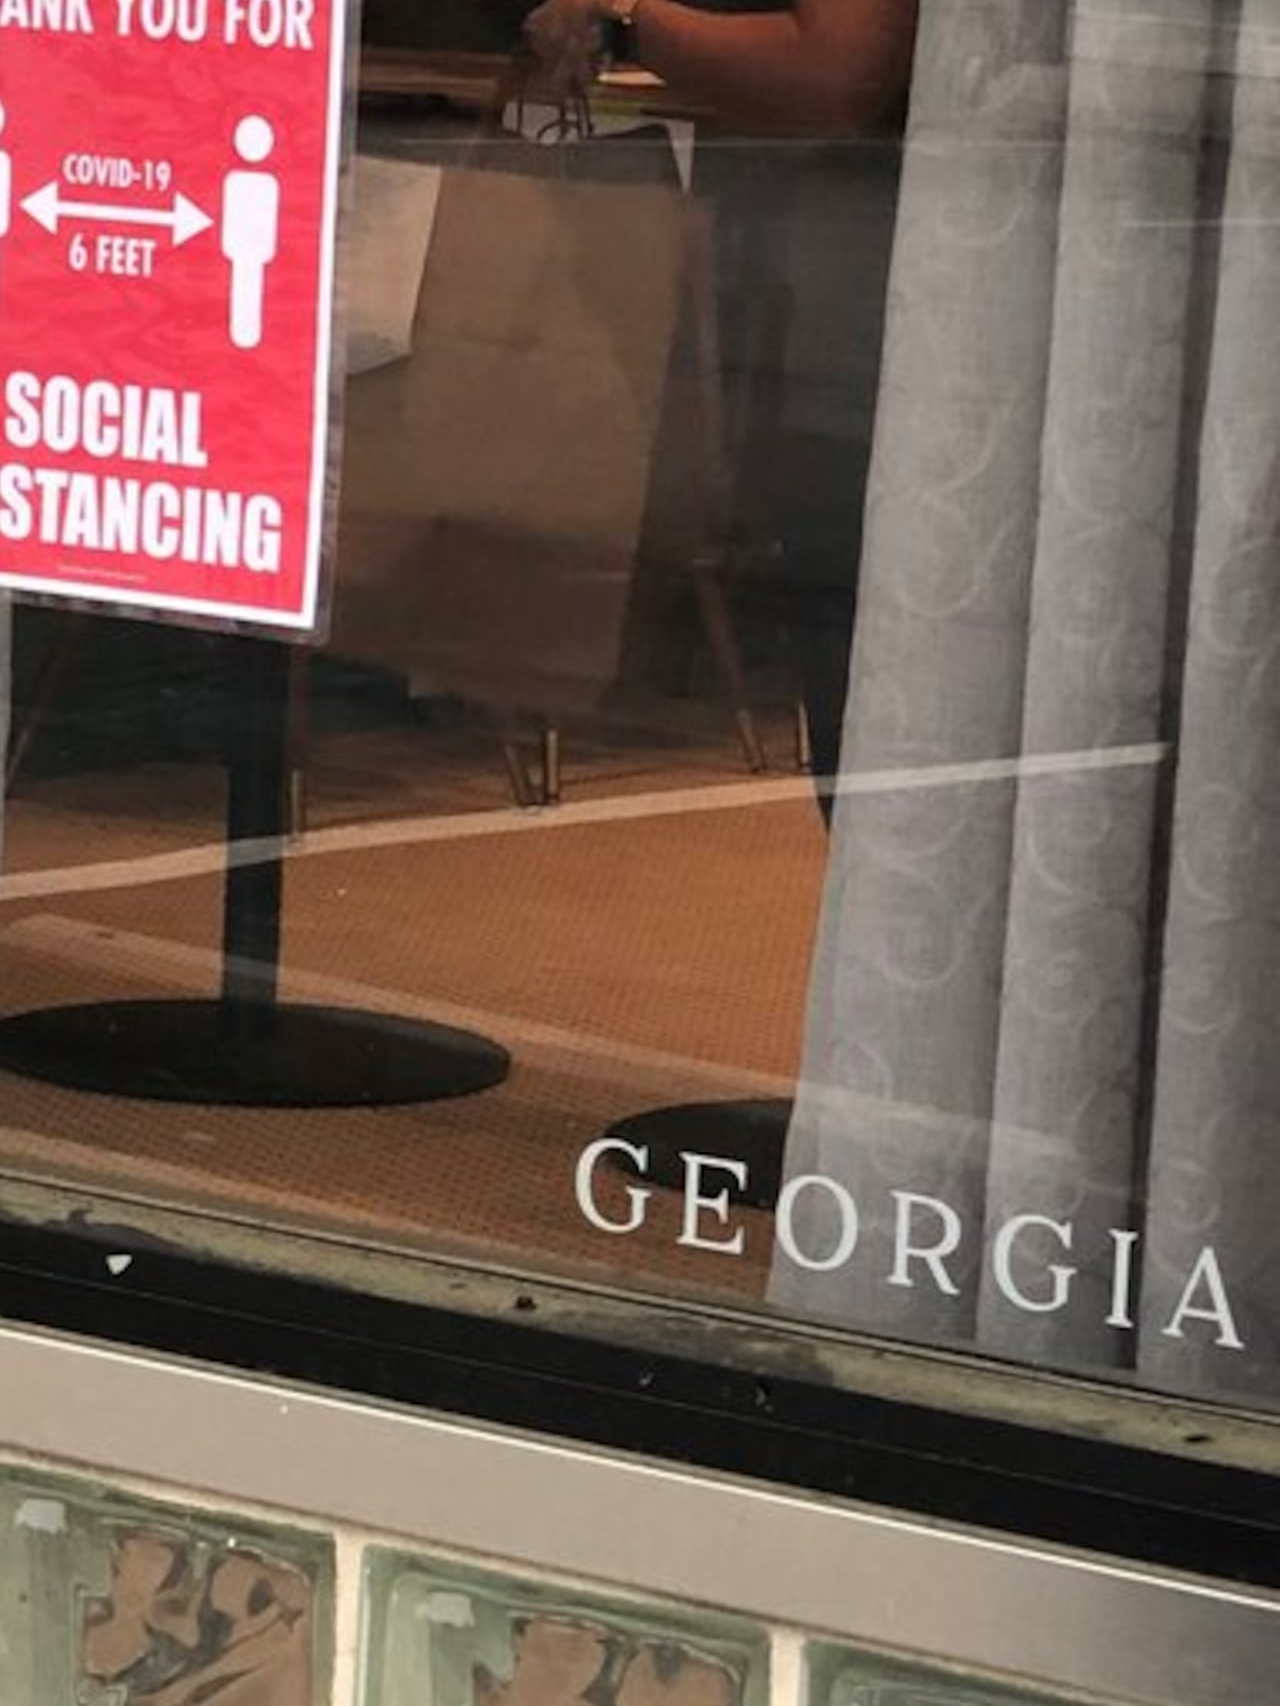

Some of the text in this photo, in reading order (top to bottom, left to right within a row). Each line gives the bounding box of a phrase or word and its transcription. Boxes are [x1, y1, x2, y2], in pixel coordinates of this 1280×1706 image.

[62, 152, 172, 192] COVID-19
[68, 233, 157, 278] 6 FEET
[3, 370, 208, 468] SOCIAL
[574, 1138, 1246, 1350] GEORGIA
